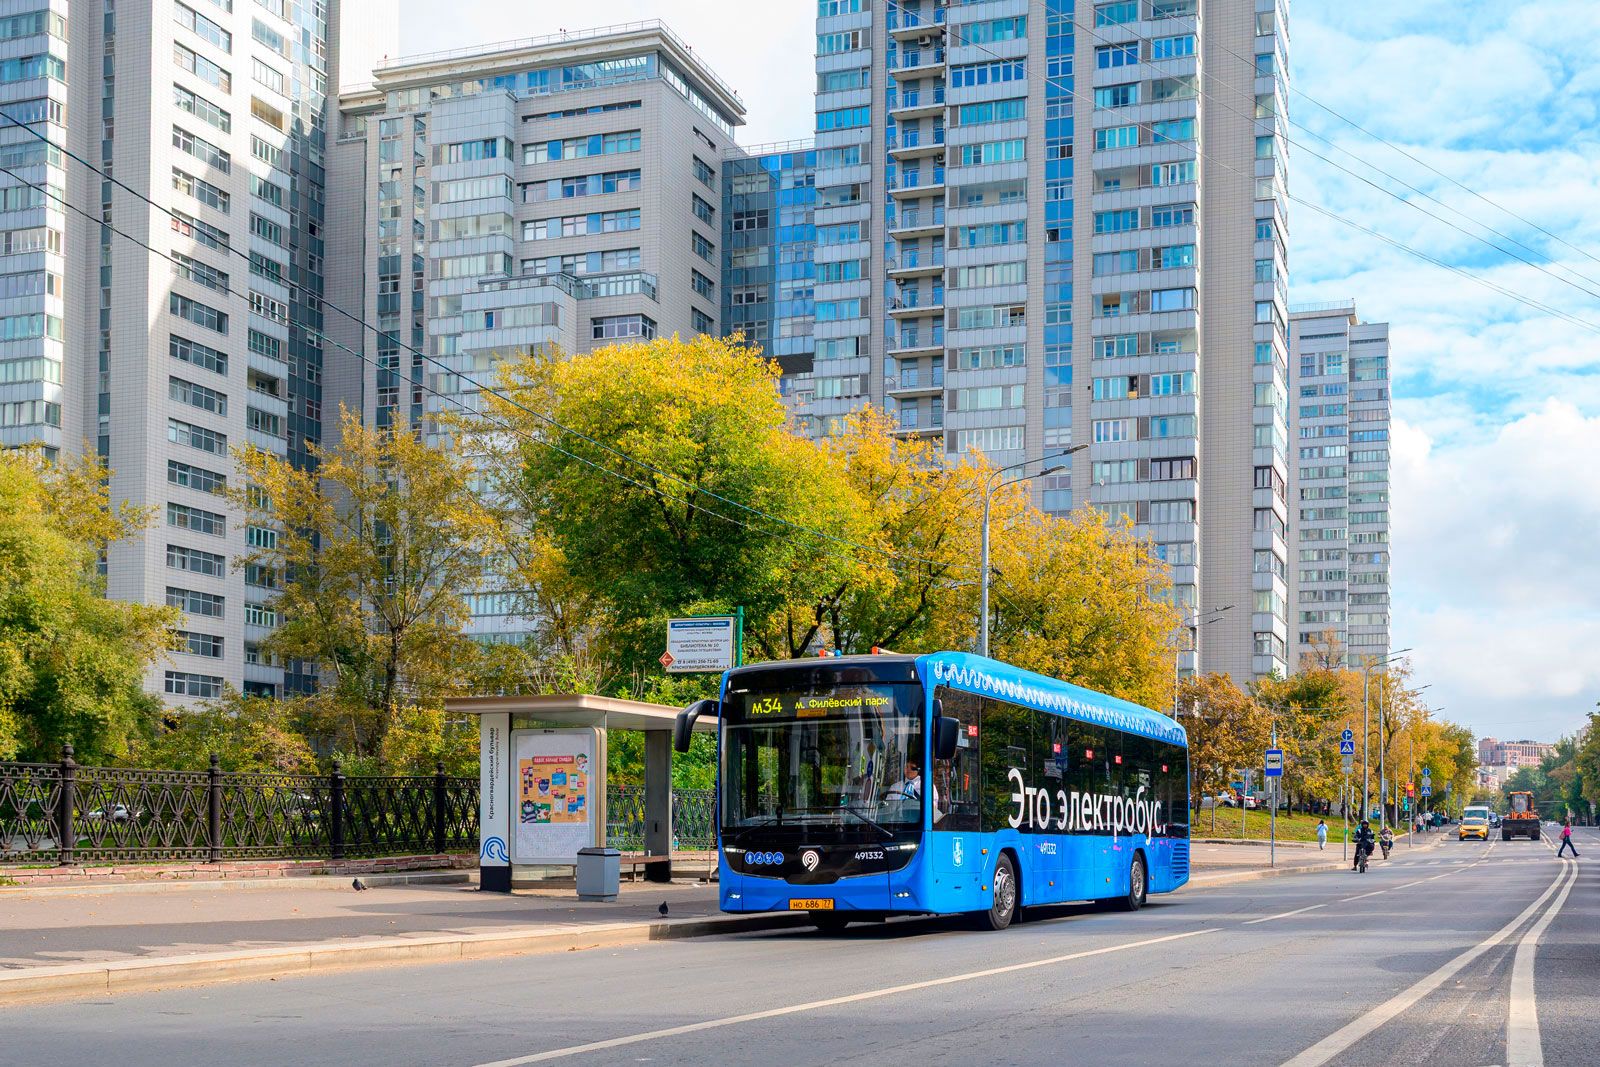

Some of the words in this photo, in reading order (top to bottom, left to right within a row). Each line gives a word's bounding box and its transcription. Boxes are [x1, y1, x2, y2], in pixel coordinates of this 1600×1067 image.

[808, 697, 863, 709] Филёвский
[866, 697, 889, 708] парк
[1008, 767, 1050, 830] Это
[1057, 786, 1167, 845] электробус.
[854, 851, 884, 860] 491332
[805, 900, 820, 909] 686
